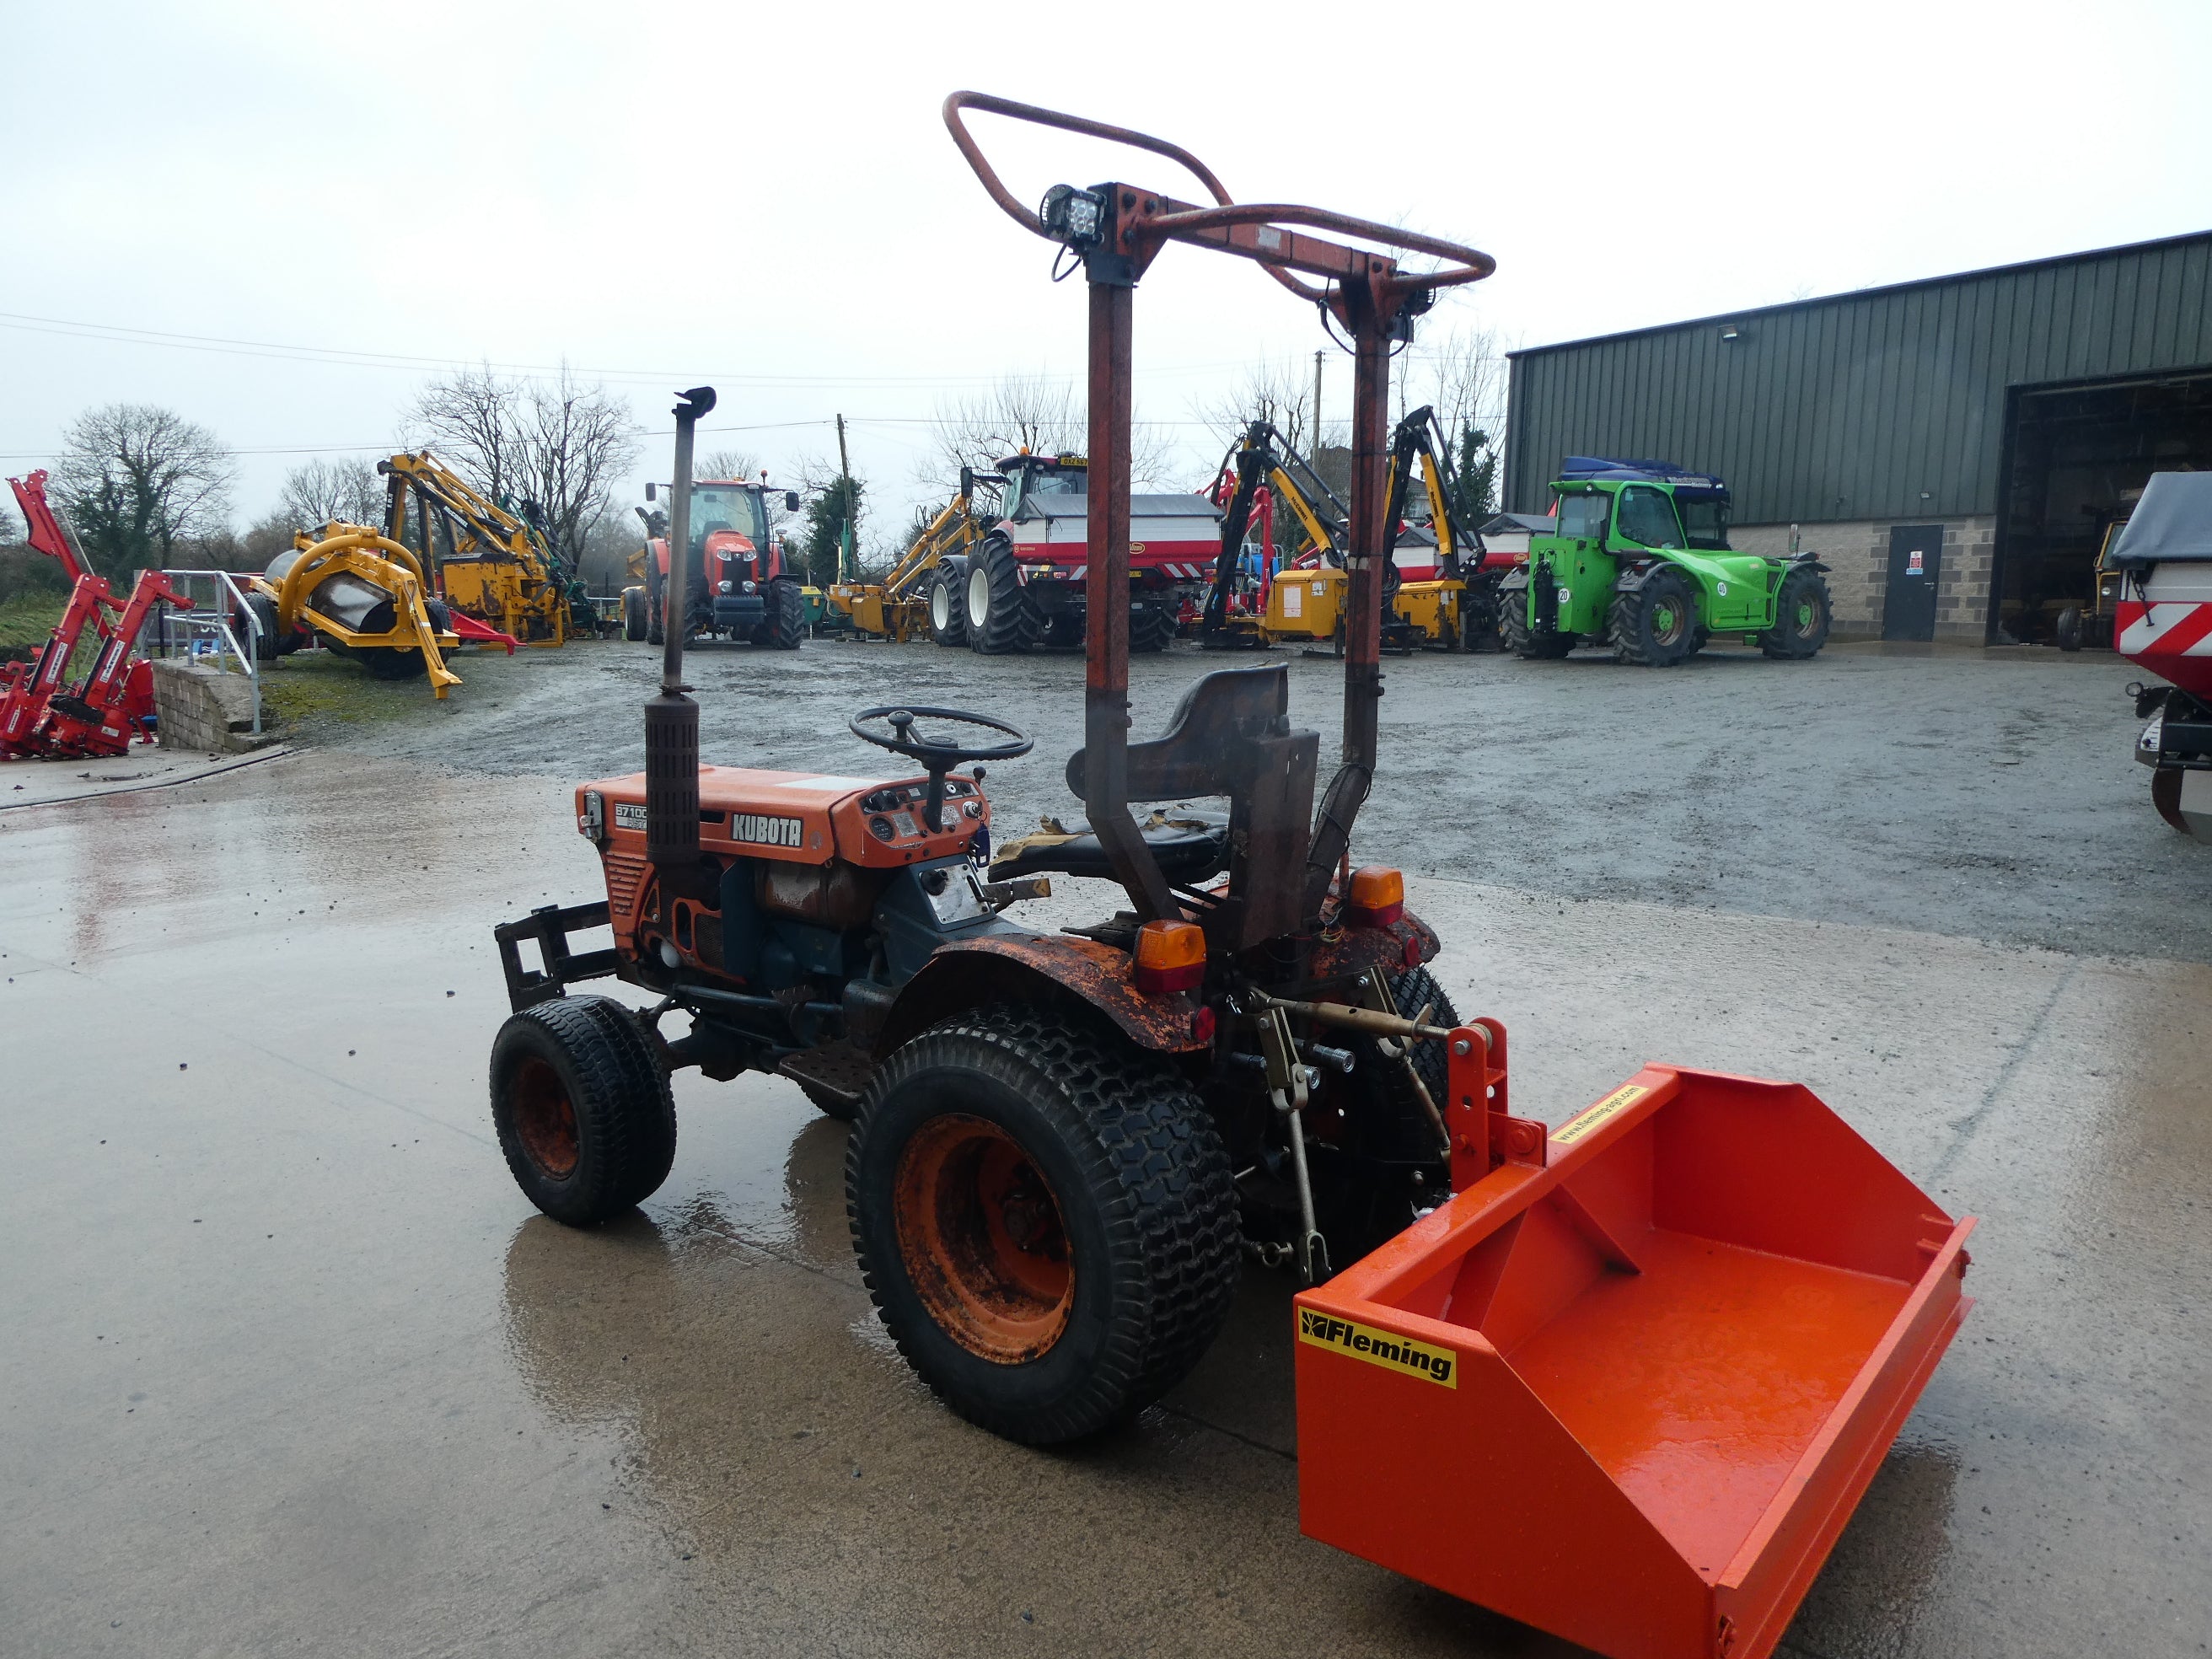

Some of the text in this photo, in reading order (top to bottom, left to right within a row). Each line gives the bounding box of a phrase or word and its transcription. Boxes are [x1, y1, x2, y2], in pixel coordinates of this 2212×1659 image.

[1560, 590, 1568, 601] 20
[1719, 583, 1726, 594] 40
[733, 813, 802, 846] KUBOTA
[1557, 1086, 1640, 1141] www.fleming-agri.com
[1325, 1318, 1452, 1382] Fleming
